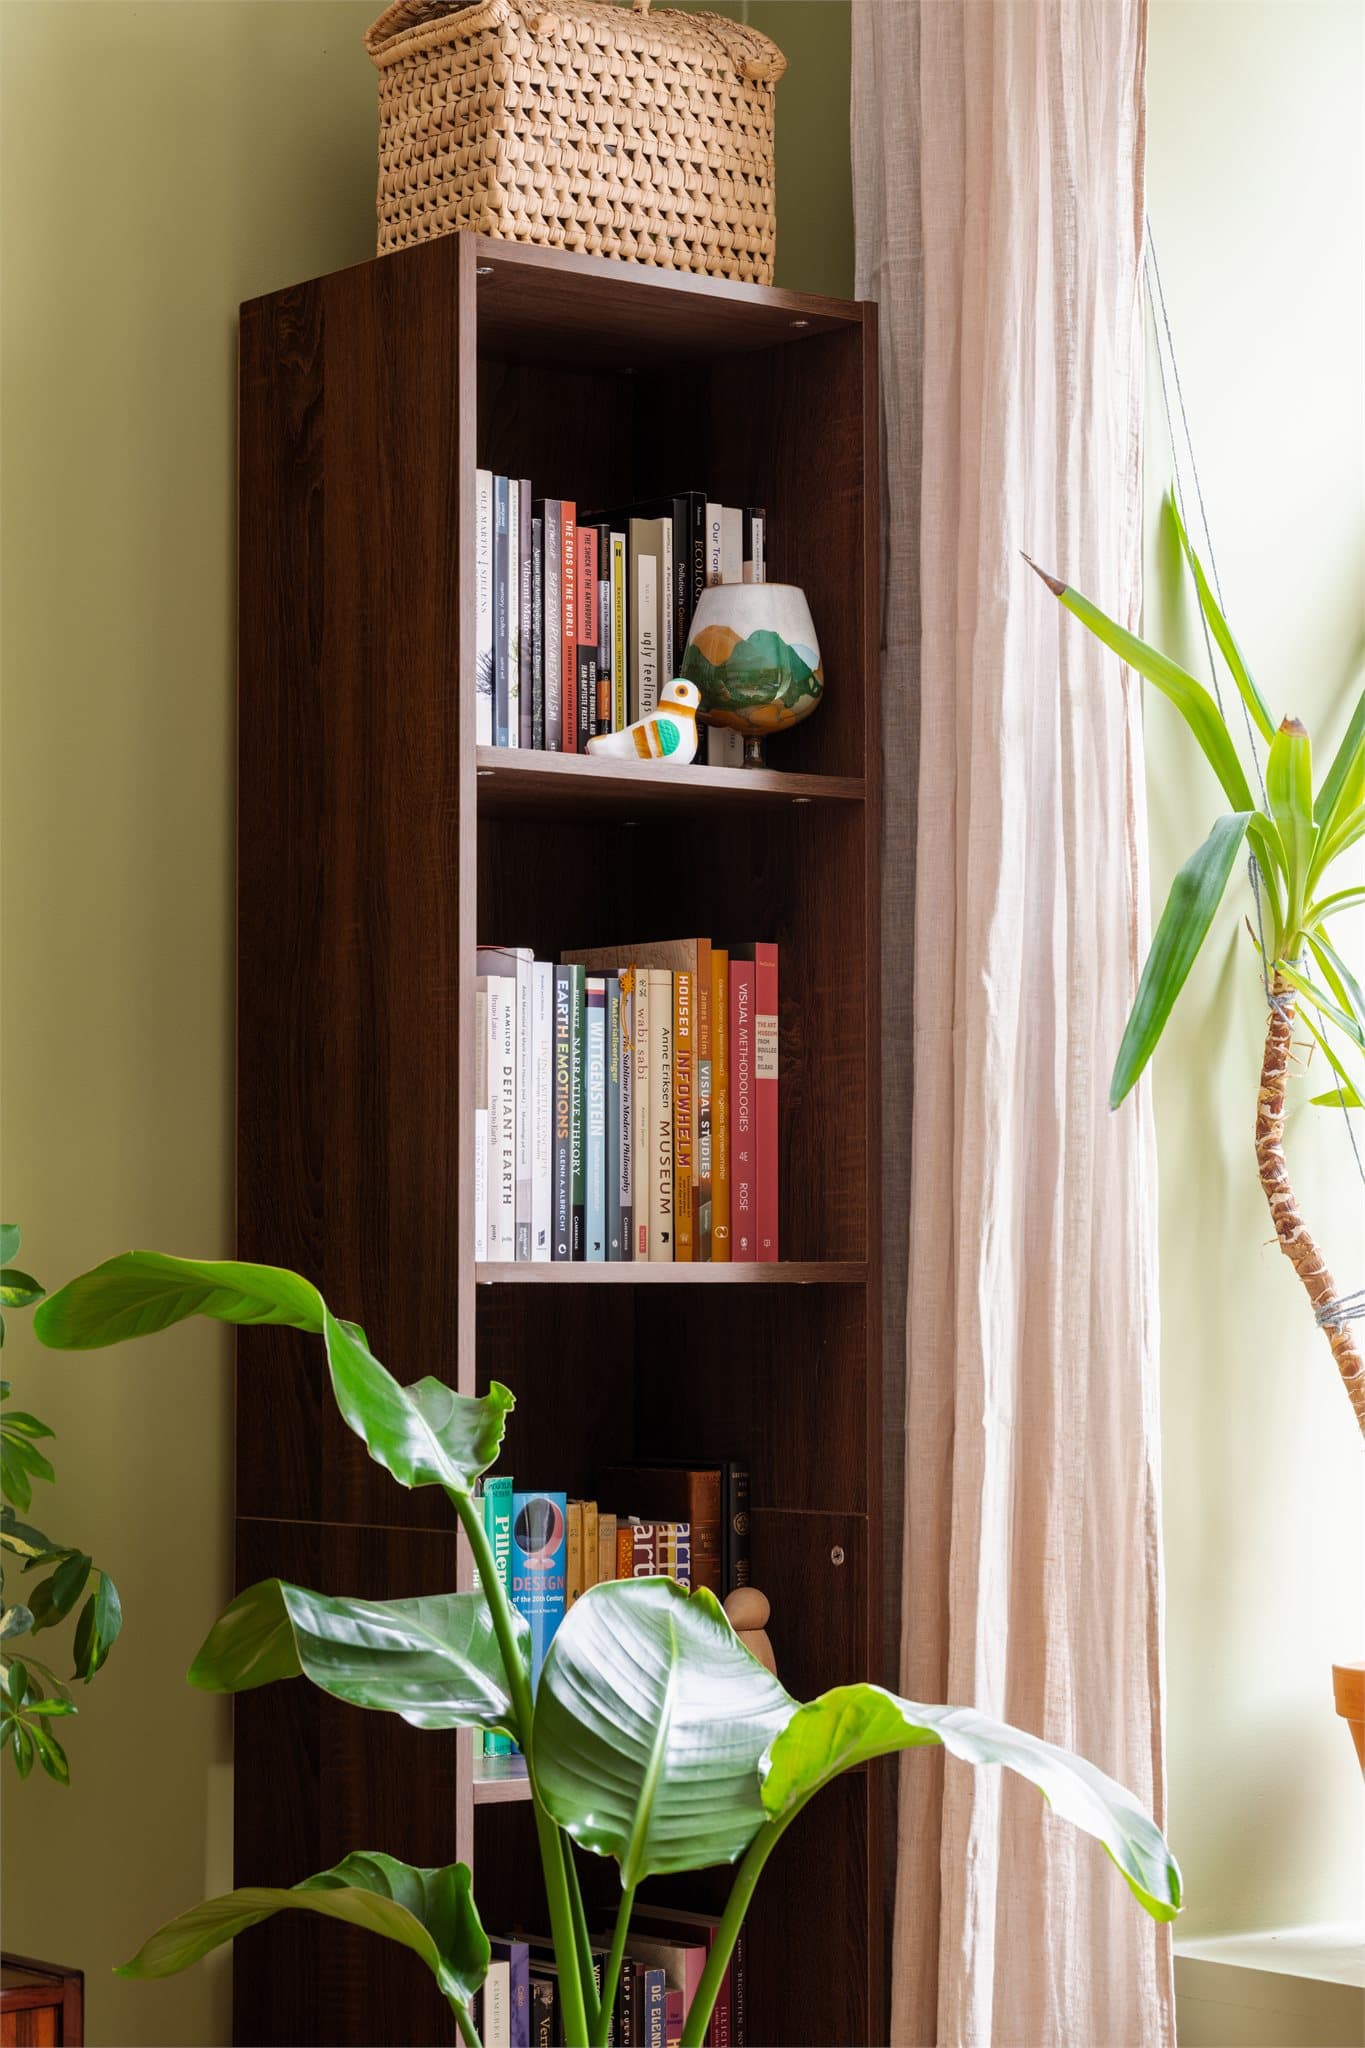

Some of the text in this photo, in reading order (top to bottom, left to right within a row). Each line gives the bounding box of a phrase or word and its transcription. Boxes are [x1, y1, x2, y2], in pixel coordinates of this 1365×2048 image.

[480, 490, 488, 513] OLE
[480, 515, 488, 556] MARTIN
[712, 522, 721, 544] Our
[523, 559, 531, 640] Vibrant Matter
[565, 520, 574, 638] THE ENDS OF THE WORLD
[584, 534, 592, 639] THE SHOCK OF THE ANTHROPOCENE
[677, 562, 686, 597] Pollution
[677, 598, 686, 606] Is
[695, 540, 704, 604] ECOLOG
[641, 632, 656, 712] ugly feelings
[637, 1008, 648, 1043] wabi
[678, 975, 689, 1037] HOUSER
[700, 990, 709, 1055] James Elkins
[490, 994, 499, 1145] Bruno Latour Down to Earth
[557, 980, 569, 1139] EARTH EMOTIONS
[611, 997, 619, 1084] Materialiseringer
[637, 1049, 648, 1080] sabi
[661, 1027, 671, 1108] Anne Eriksen
[738, 983, 748, 1133] VISUAL METHODOLOGIES
[590, 1022, 604, 1136] WITTGENSTEIN
[622, 1053, 630, 1092] Sublime
[622, 1093, 630, 1103] in
[503, 1005, 512, 1205] HAMILTON DEFIANT EARTH
[572, 1037, 581, 1176] NARRATIVE THEORY
[622, 1103, 630, 1141] Modern
[677, 1049, 690, 1168] INFOWHELM
[700, 1065, 710, 1179] VISUAL STUDIES
[717, 1088, 726, 1124] Tingenes
[559, 1179, 566, 1188] A.
[622, 1142, 630, 1195] Philosophy
[659, 1120, 671, 1215] MUSEUM
[739, 1182, 748, 1212] ROSE
[512, 1575, 564, 1592] DESIGN
[512, 1595, 520, 1603] of
[521, 1595, 531, 1603] the
[546, 1594, 564, 1603] Century
[651, 1984, 661, 2002] DE
